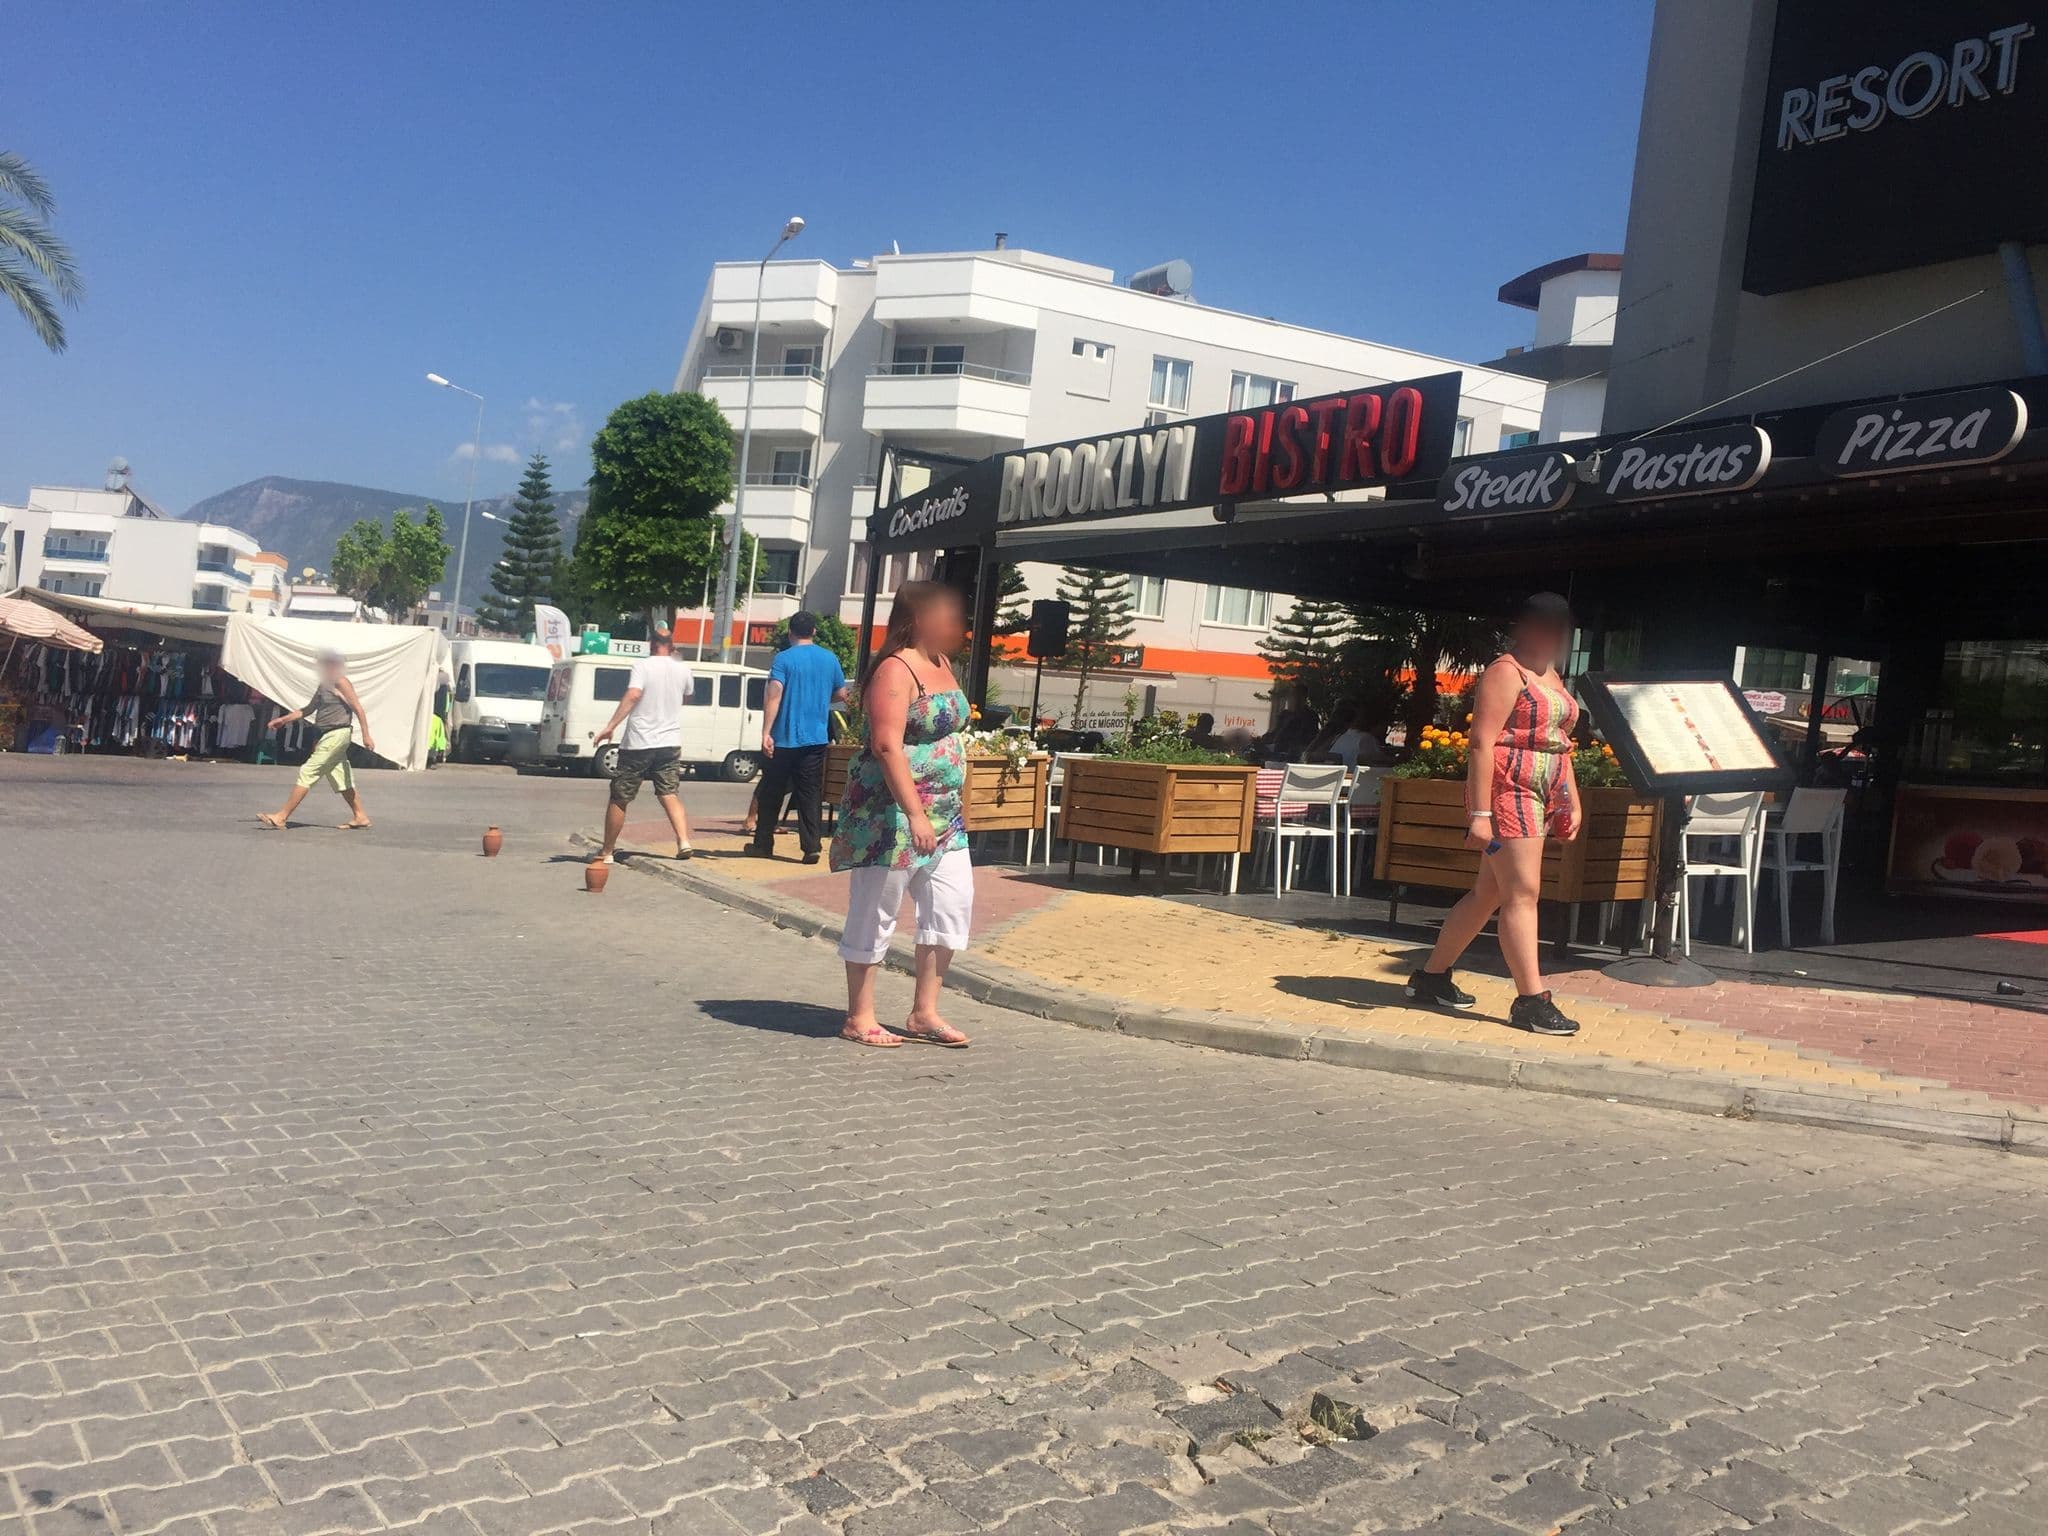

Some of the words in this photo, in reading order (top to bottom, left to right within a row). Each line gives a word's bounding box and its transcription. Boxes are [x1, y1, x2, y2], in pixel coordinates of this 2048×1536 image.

[1777, 22, 2035, 151] RESORT
[996, 424, 1196, 523] BROOKLYN
[1219, 387, 1423, 496] BISTRO
[1838, 406, 1992, 465] Pizza
[1444, 456, 1563, 512] Steak
[1606, 442, 1752, 495] Pastas
[888, 486, 968, 539] Cocktails
[615, 642, 641, 653] TEB
